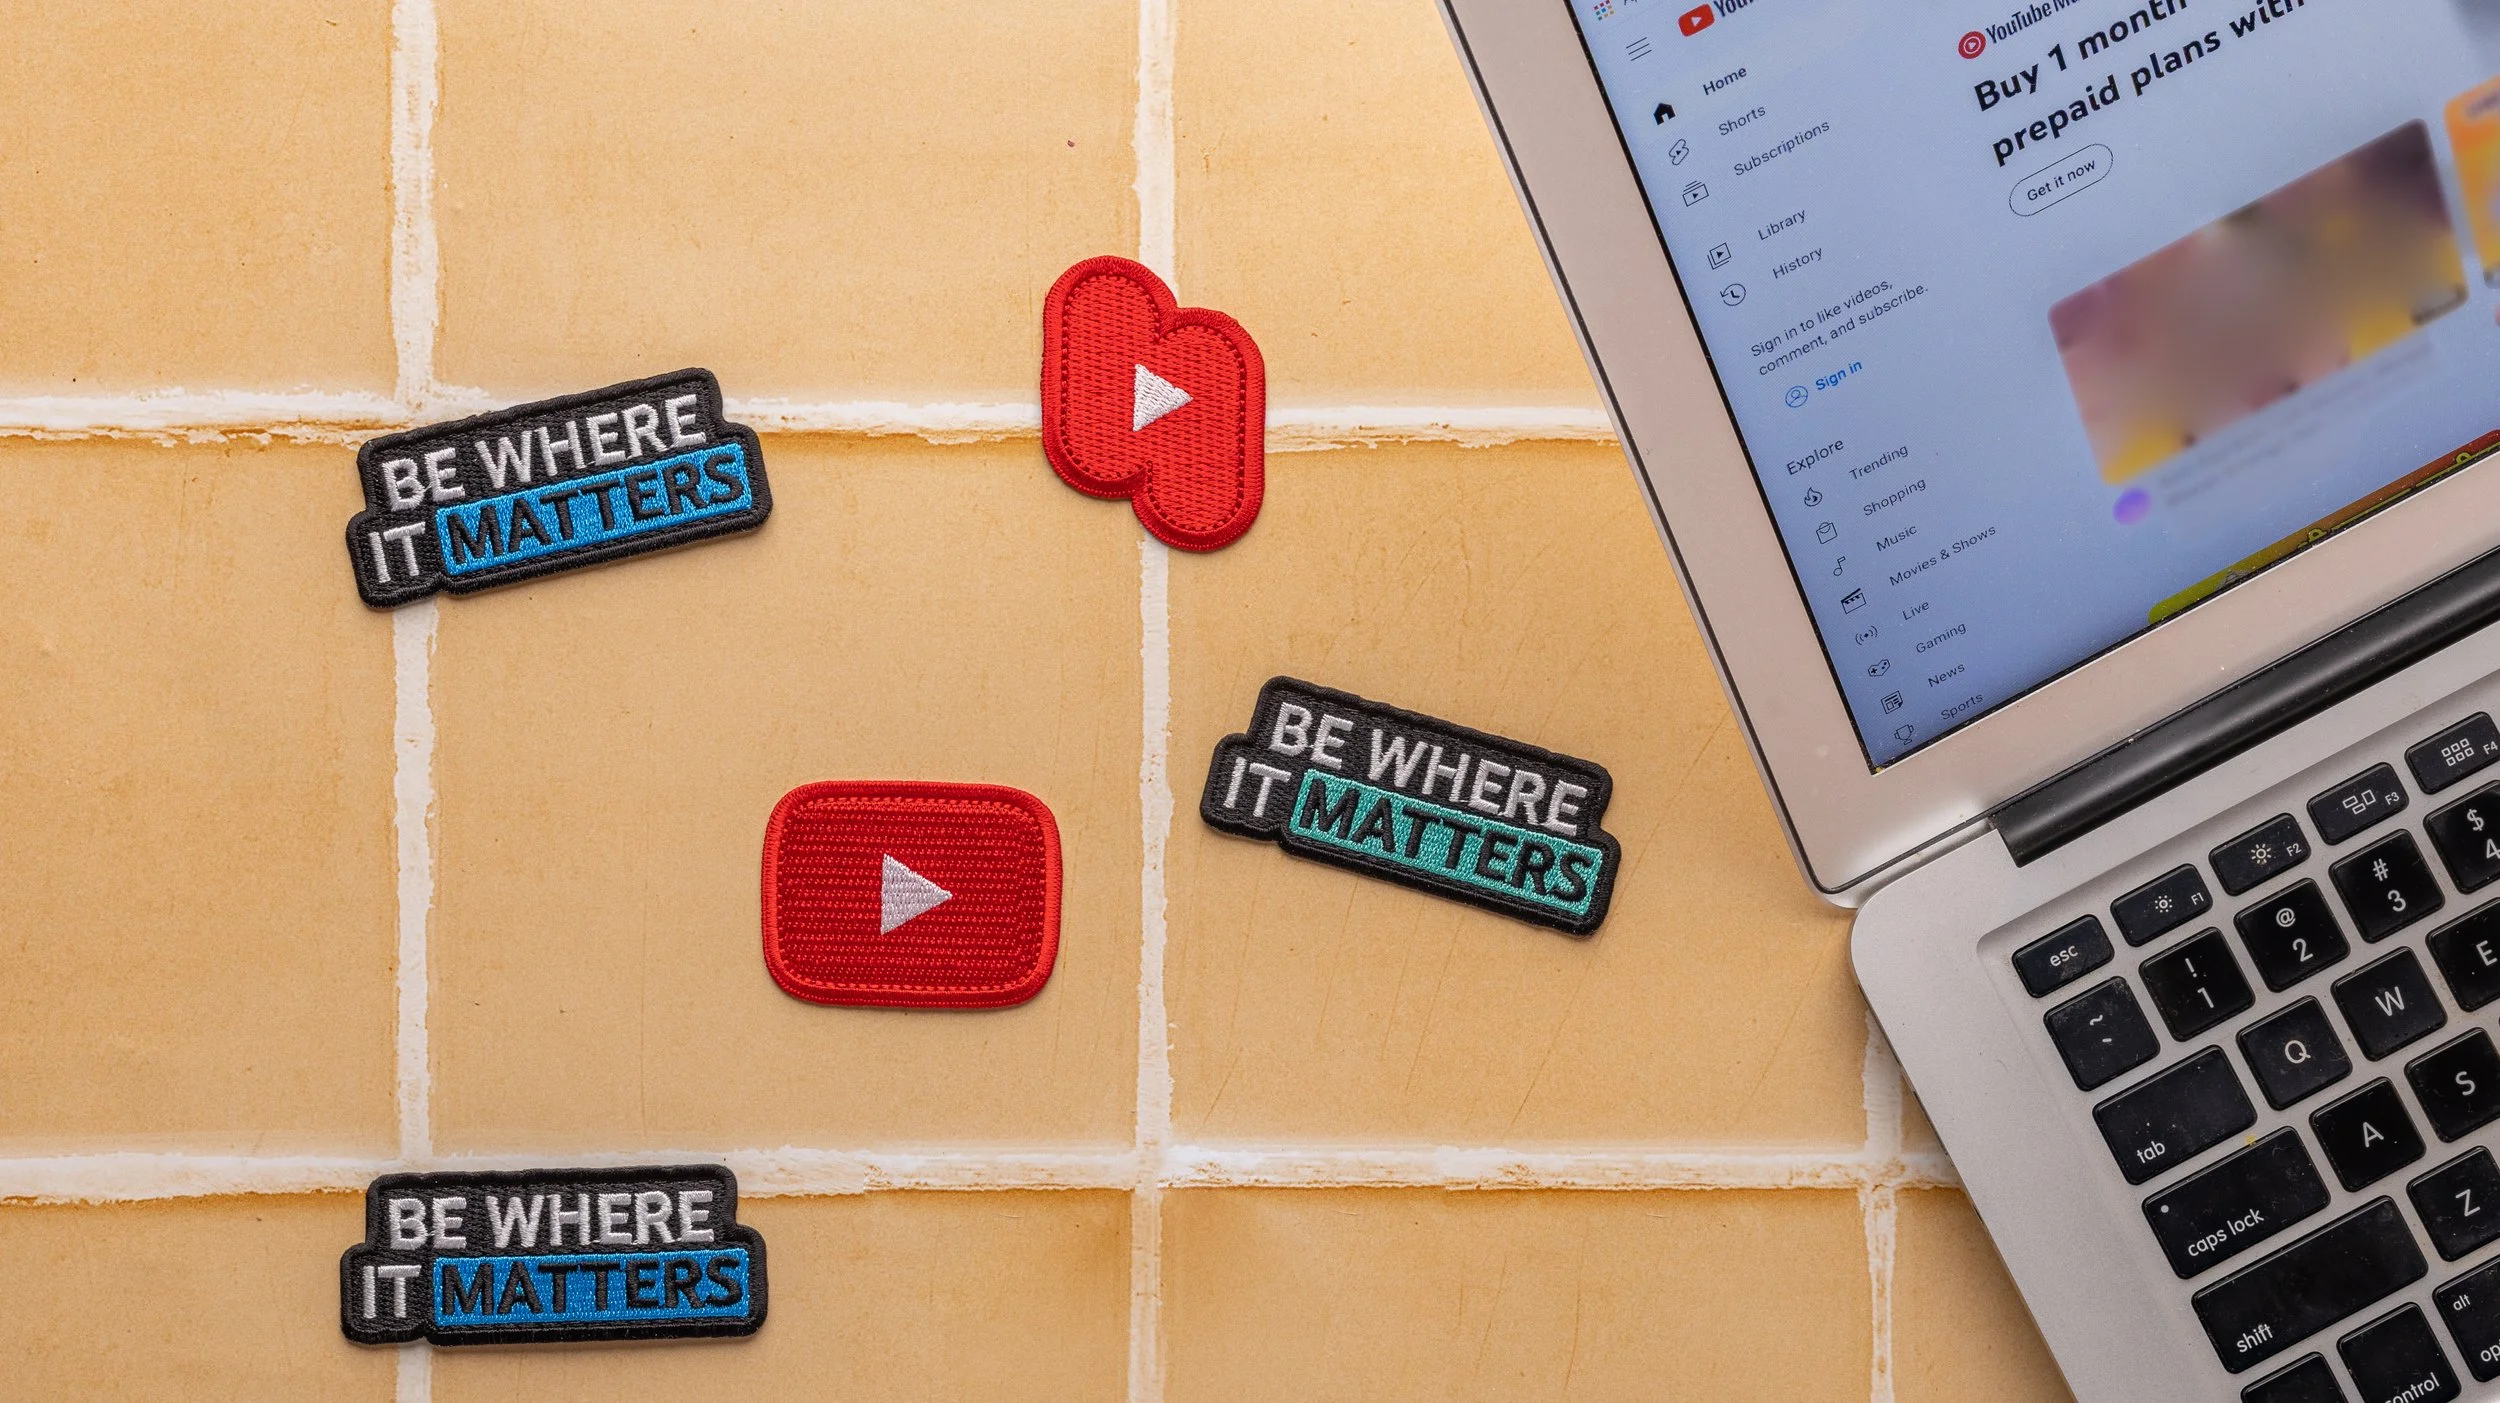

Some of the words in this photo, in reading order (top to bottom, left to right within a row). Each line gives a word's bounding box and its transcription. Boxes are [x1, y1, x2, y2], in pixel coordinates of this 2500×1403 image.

[1986, 4, 2052, 44] YouTube
[1702, 65, 1747, 96] Home
[1974, 64, 2039, 111] Buy
[2048, 44, 2068, 71] 1
[1992, 74, 2120, 167] prepaid
[2131, 30, 2221, 96] plans
[1718, 104, 1766, 136] Shorts
[1734, 120, 1830, 176] Subscriptions
[2026, 180, 2052, 202] Get
[2054, 174, 2064, 188] it
[2066, 158, 2096, 183] now
[1758, 209, 1806, 240] Library
[1772, 247, 1822, 279] History
[1751, 335, 1782, 357] Sign
[1785, 326, 1798, 341] in
[1800, 320, 1814, 332] to
[1817, 304, 1841, 324] like
[1843, 279, 1893, 310] videos,
[1760, 335, 1828, 376] comment,
[1830, 318, 1856, 340] and
[1859, 283, 1928, 325] subscribe.
[1816, 369, 1846, 391] Sign
[1850, 360, 1862, 375] in
[380, 447, 465, 512] BE
[474, 394, 706, 489] WHERE
[1786, 437, 1844, 475] Explore
[1849, 444, 1909, 481] Trending
[1863, 477, 1927, 517] Shopping
[368, 522, 425, 584] IT
[448, 454, 745, 564] MATTERS
[1876, 524, 1918, 552] Music
[1889, 556, 1938, 586] Movies
[1940, 548, 1951, 561] &
[1952, 525, 1997, 555] Shows
[1902, 600, 1930, 621] Live
[1915, 622, 1967, 655] Gaming
[1928, 662, 1966, 688] News
[1940, 693, 1984, 721] Sports
[2483, 741, 2498, 755] F4
[1269, 702, 1353, 769] BE
[1366, 729, 1587, 836] WHERE
[2385, 791, 2400, 805] F3
[1223, 756, 1292, 817] IT
[1300, 779, 1592, 901] MATTERS
[2466, 808, 2484, 831] $
[2286, 843, 2302, 857] F2
[2486, 838, 2500, 859] 4
[2373, 859, 2390, 882] #
[2191, 892, 2204, 906] F1
[2387, 889, 2406, 912] 3
[2276, 907, 2296, 928] @
[2049, 944, 2079, 968] esc
[2292, 938, 2313, 962] 2
[2476, 940, 2498, 966] E
[2184, 957, 2198, 978] !
[2197, 987, 2214, 1009] 1
[2375, 986, 2405, 1017] W
[2284, 1039, 2311, 1064] Q
[2456, 1071, 2476, 1096] S
[2362, 1121, 2384, 1148] A
[2136, 1140, 2166, 1164] tab
[2456, 1189, 2480, 1217] Z
[388, 1196, 467, 1250] BE
[485, 1190, 714, 1248] WHERE
[2187, 1227, 2228, 1258] caps
[2229, 1208, 2265, 1234] lock
[362, 1264, 421, 1318] IT
[442, 1256, 742, 1316] MATTERS
[2453, 1294, 2471, 1311] alt
[2236, 1323, 2273, 1354] shift
[2481, 1343, 2500, 1361] op
[2385, 1372, 2440, 1403] ontrol
